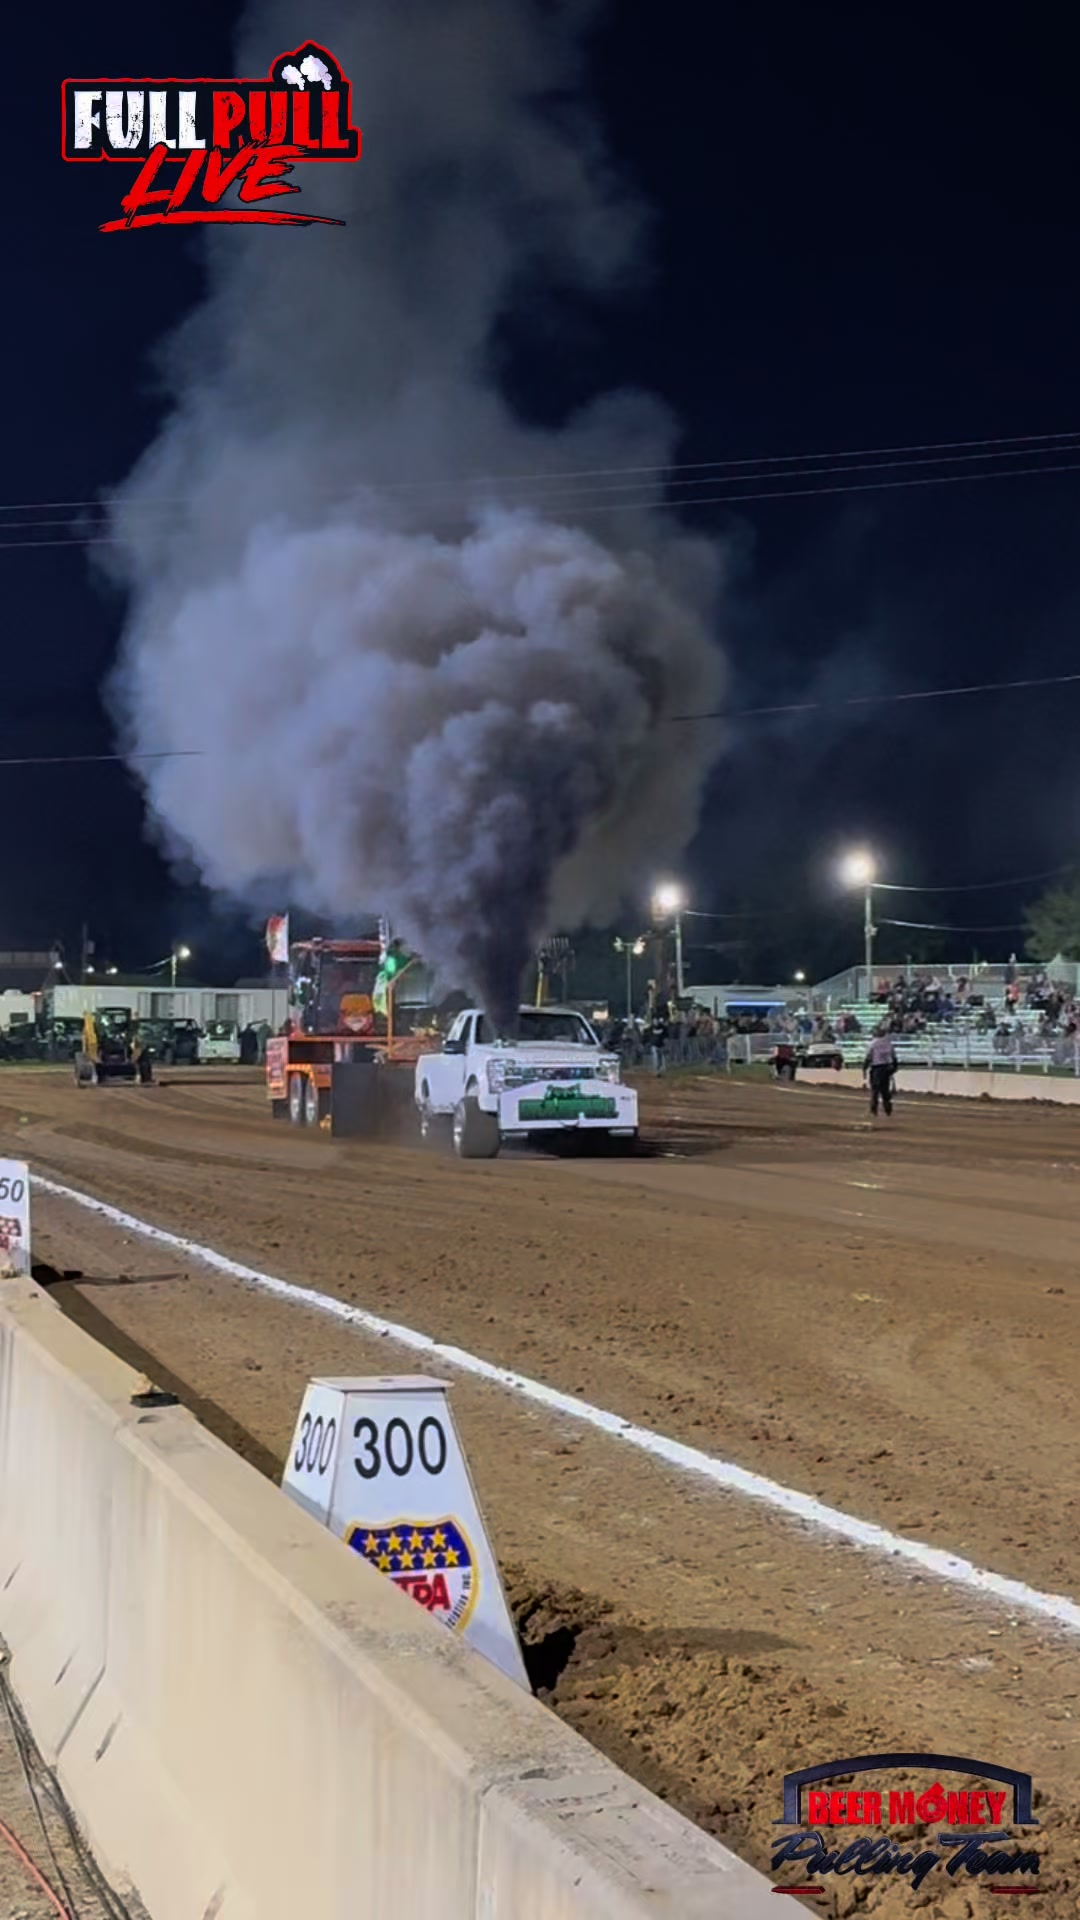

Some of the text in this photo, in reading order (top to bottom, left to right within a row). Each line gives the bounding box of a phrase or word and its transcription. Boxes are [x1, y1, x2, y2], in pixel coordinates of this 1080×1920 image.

[0, 1178, 24, 1202] 50
[295, 1412, 336, 1476] 300
[353, 1416, 447, 1479] 300
